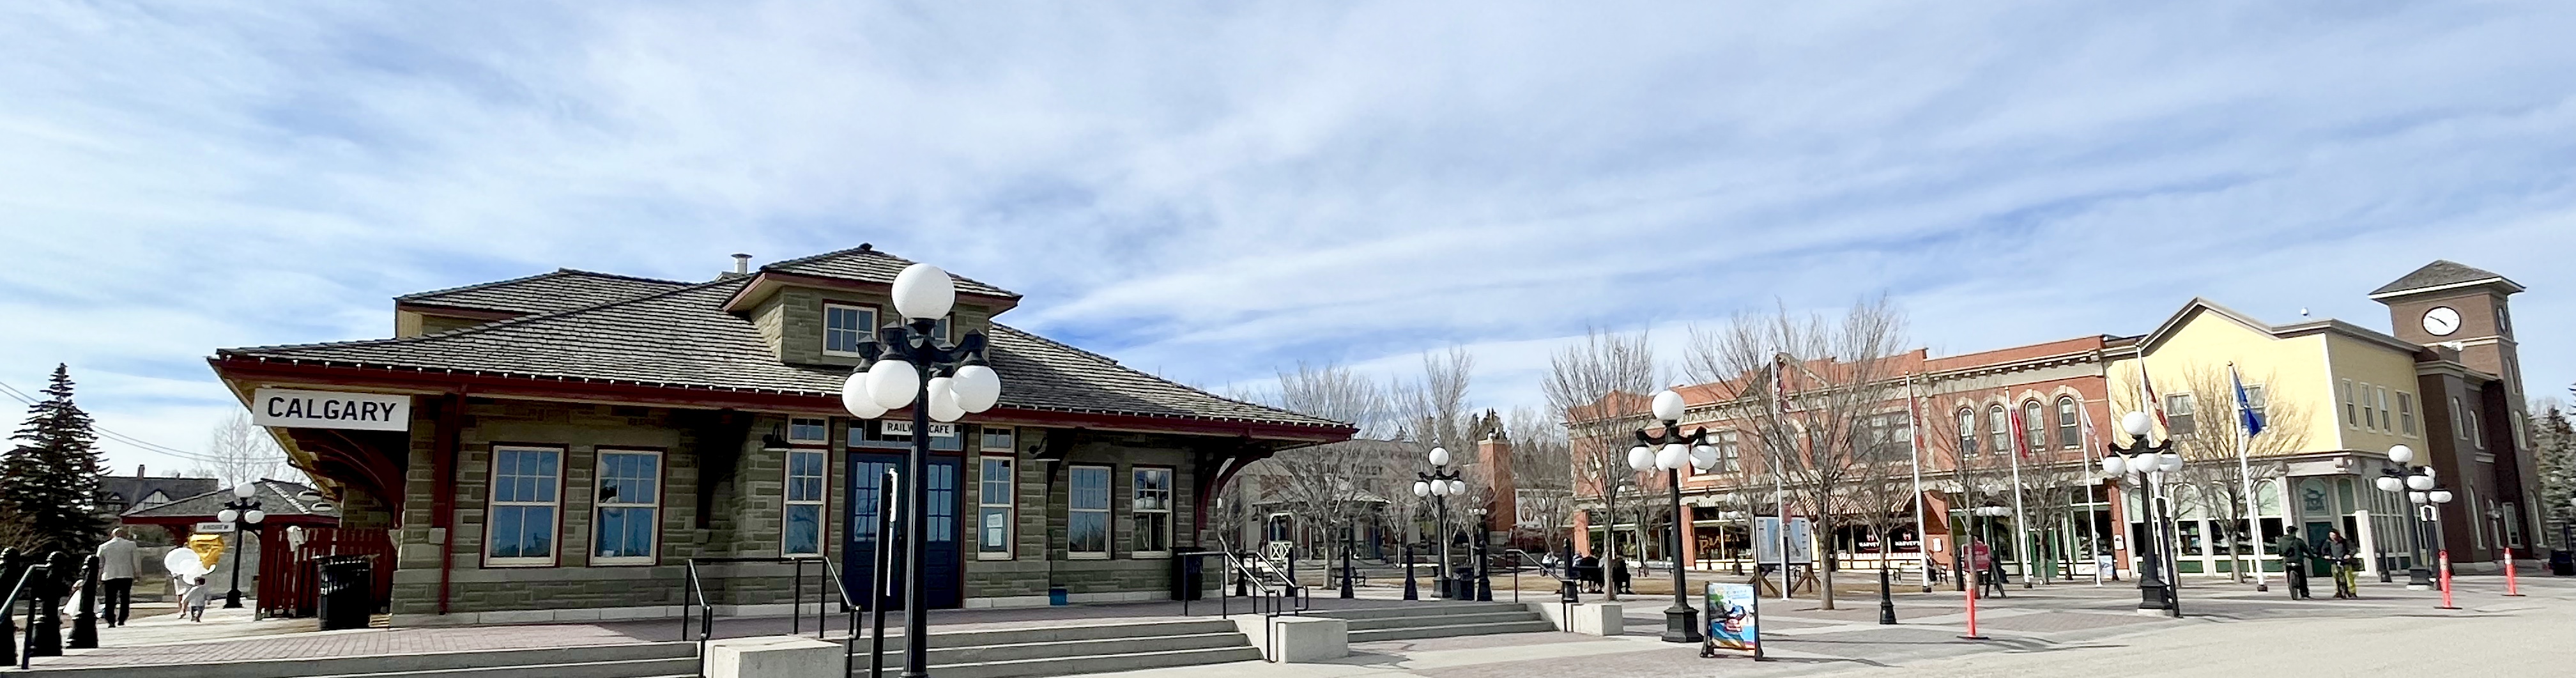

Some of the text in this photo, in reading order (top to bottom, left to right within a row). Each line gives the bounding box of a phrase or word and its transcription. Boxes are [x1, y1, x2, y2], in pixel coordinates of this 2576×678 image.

[268, 396, 397, 422] CALGARY
[887, 422, 949, 434] RAILW CAFE
